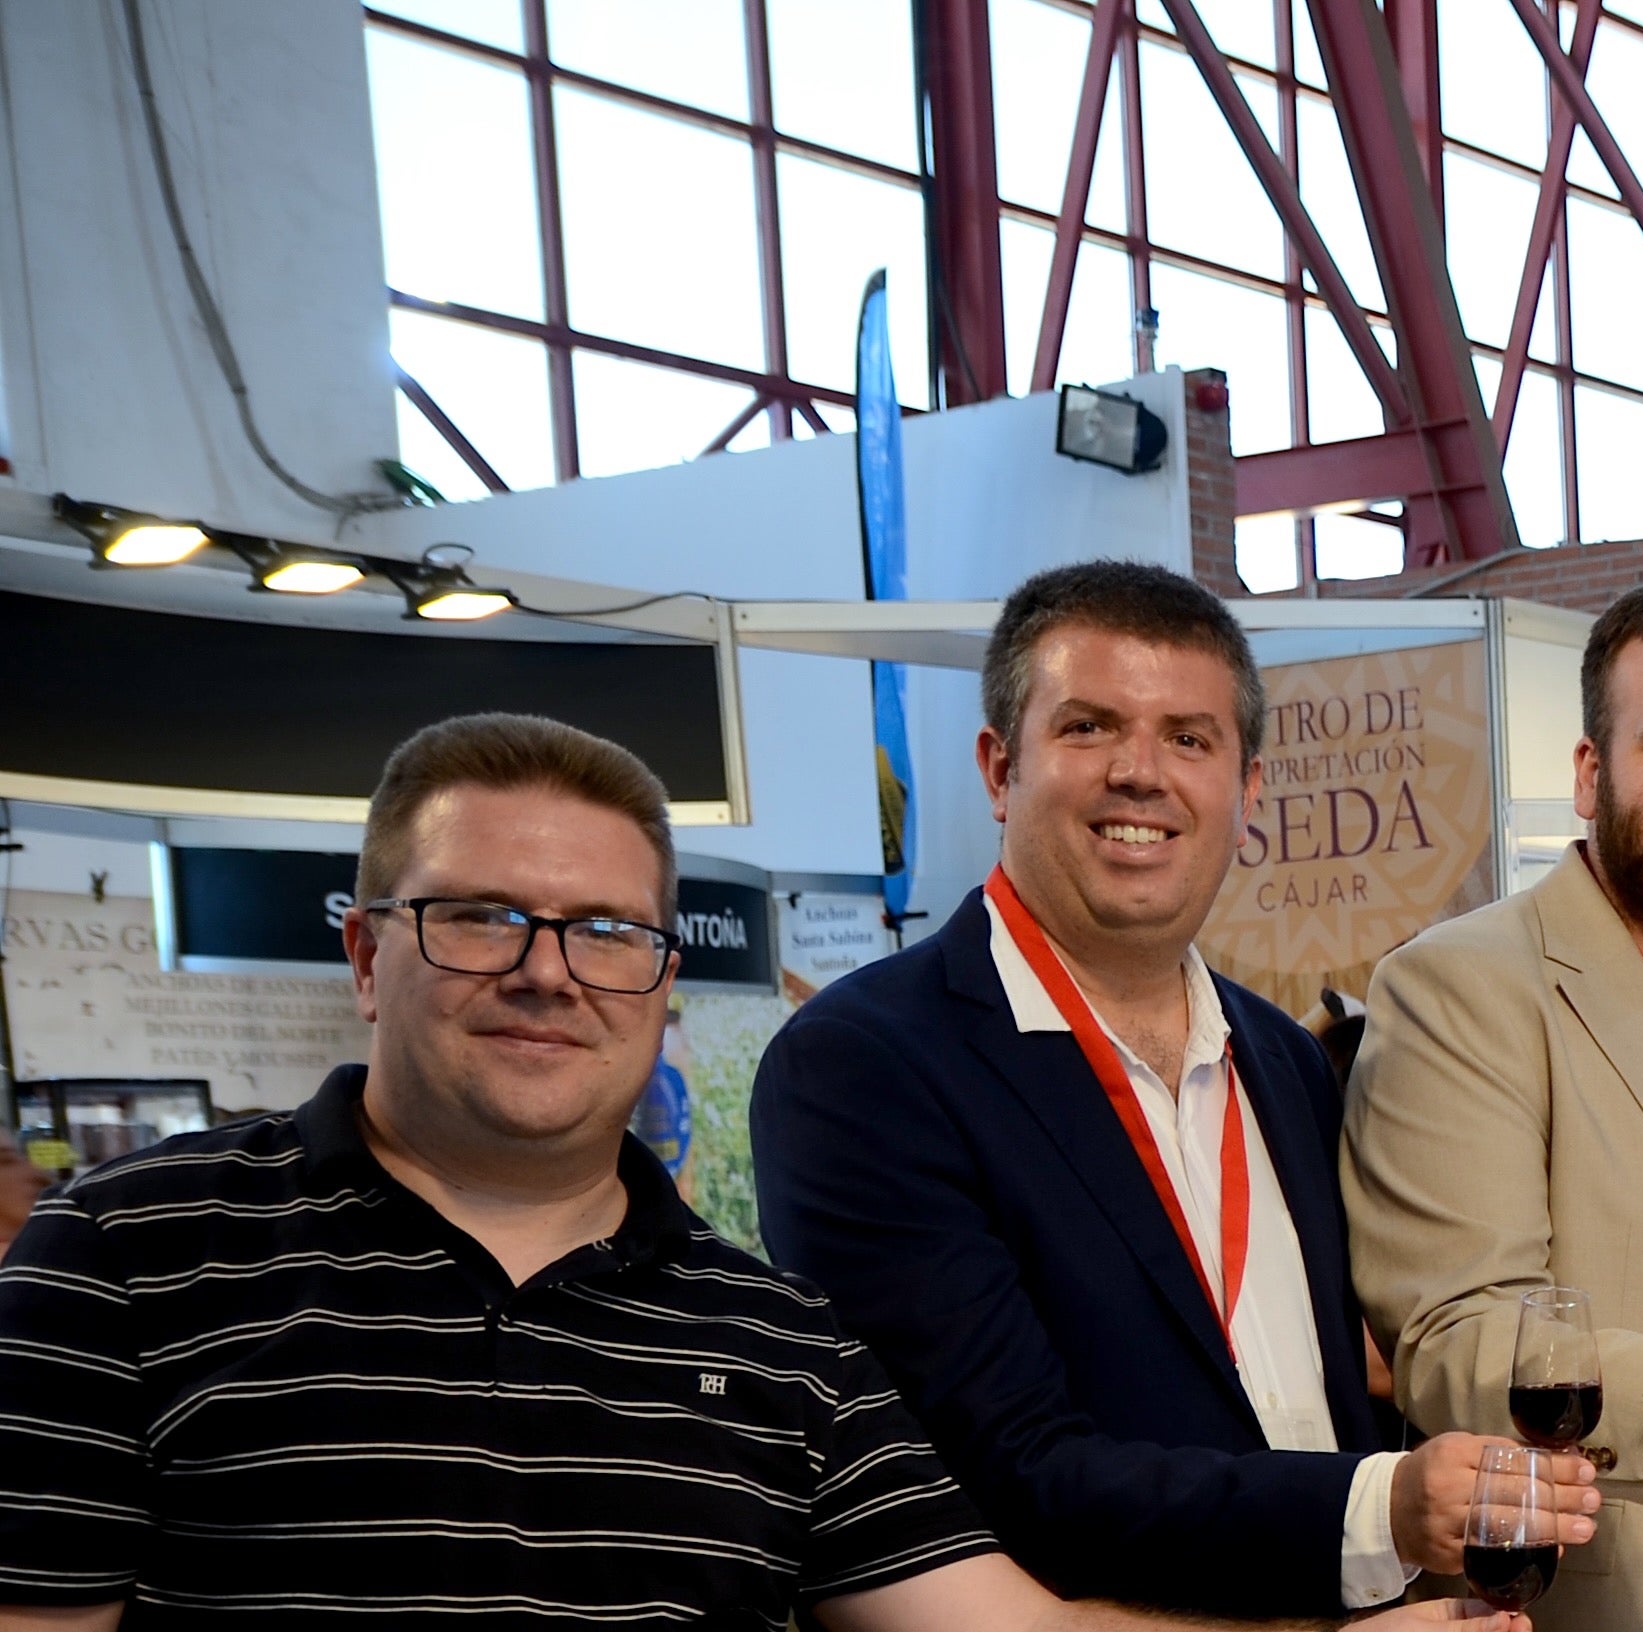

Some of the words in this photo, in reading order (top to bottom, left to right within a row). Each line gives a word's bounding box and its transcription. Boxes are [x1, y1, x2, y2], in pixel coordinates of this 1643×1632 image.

[1268, 695, 1351, 747] TRO
[1363, 686, 1425, 736] DE
[1262, 739, 1426, 787] PRETACIÓN
[1257, 873, 1369, 912] CÁJAR
[677, 907, 748, 950] NTOÑA
